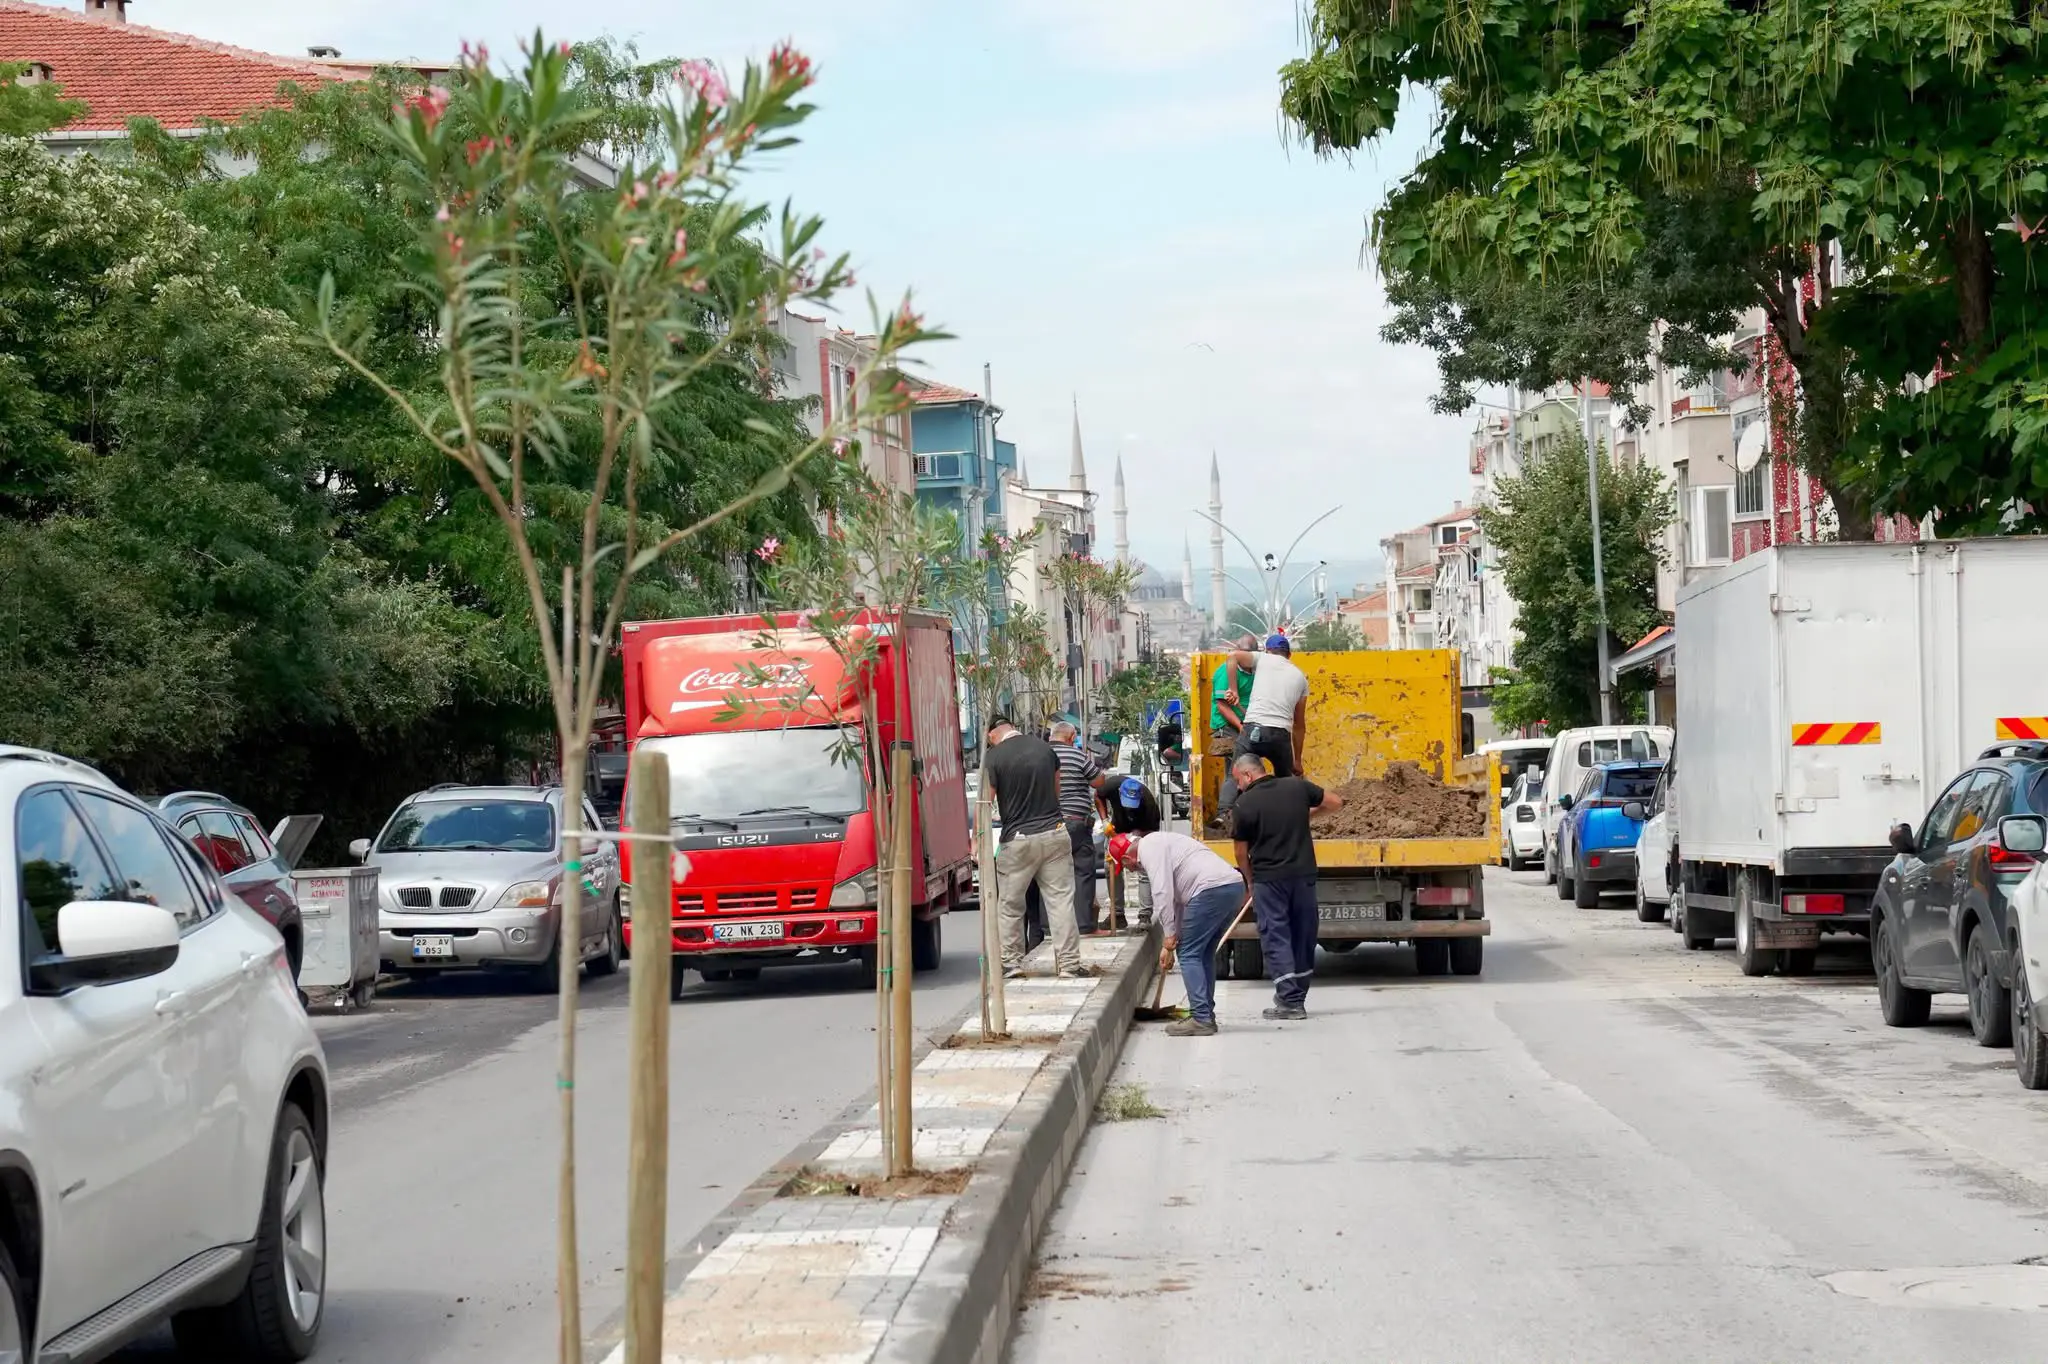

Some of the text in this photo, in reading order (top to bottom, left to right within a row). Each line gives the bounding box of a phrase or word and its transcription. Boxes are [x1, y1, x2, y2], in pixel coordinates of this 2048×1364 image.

[717, 834, 769, 846] ISUZU
[1318, 906, 1381, 920] 22 ABZ 863
[719, 924, 781, 937] 22 NK 236
[416, 938, 427, 946] 22
[425, 947, 442, 955] 053
